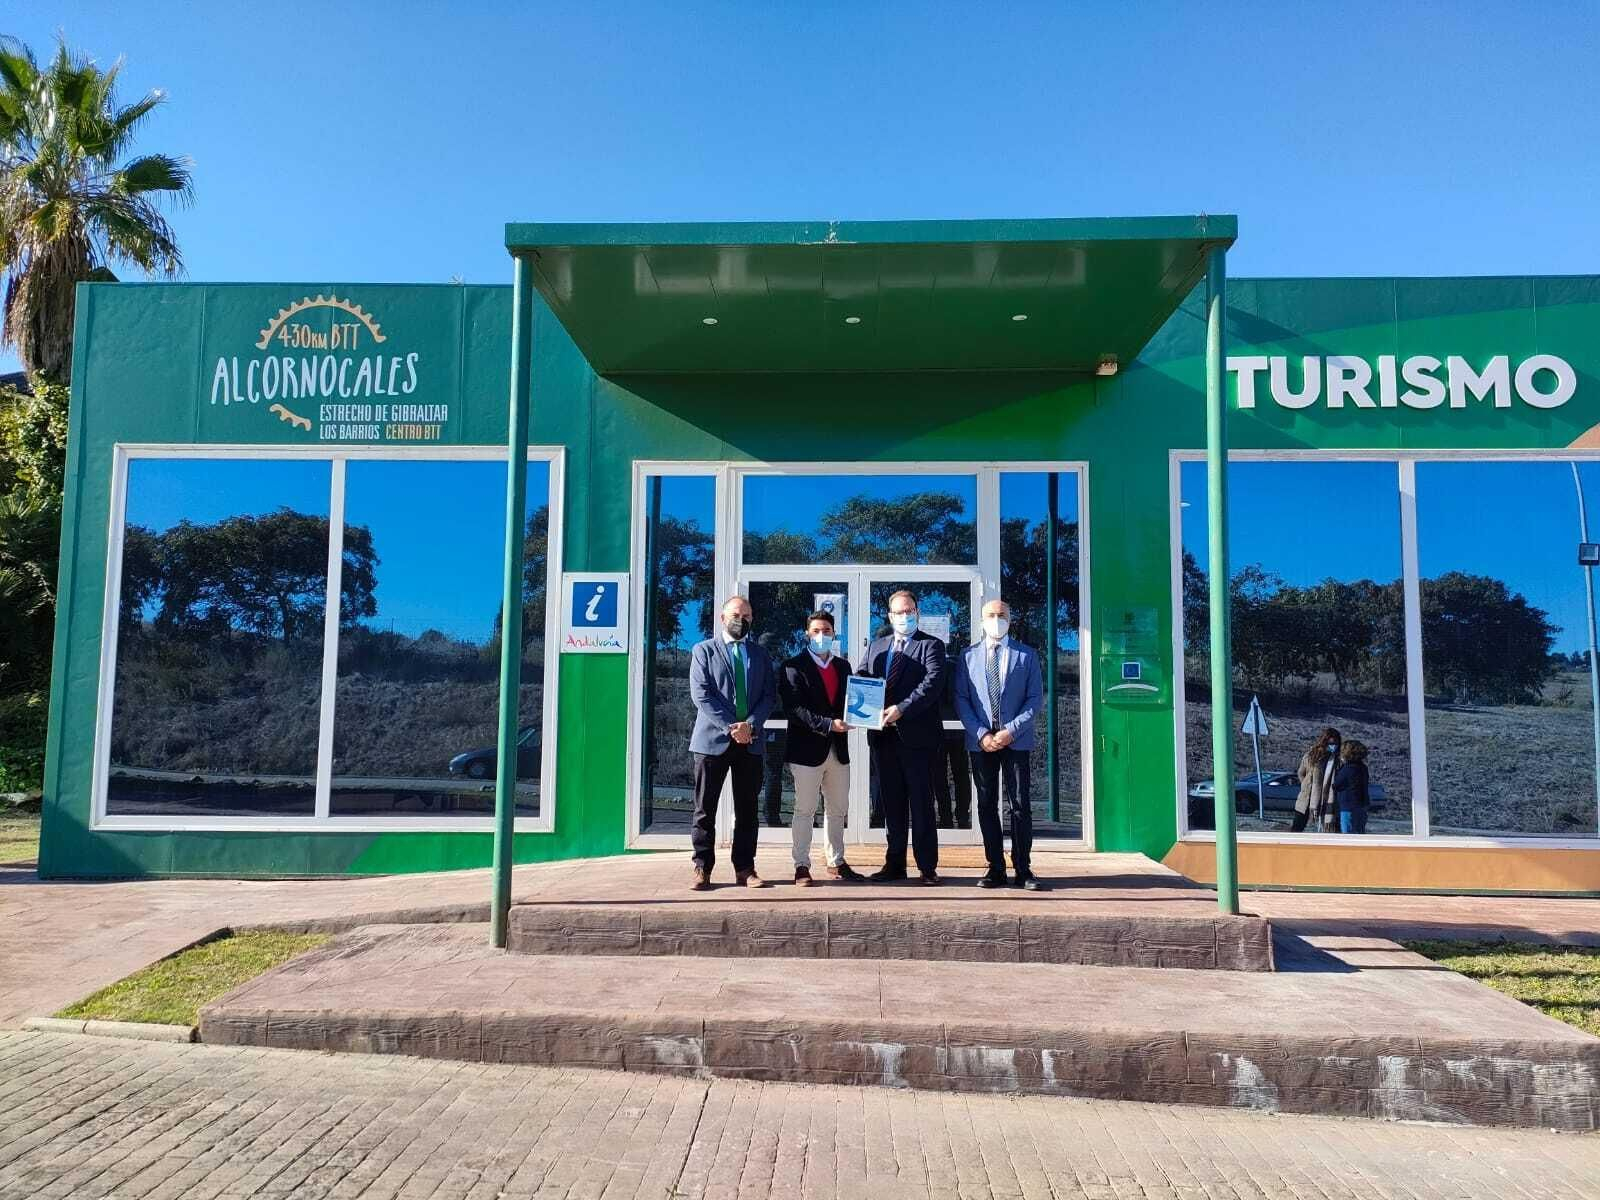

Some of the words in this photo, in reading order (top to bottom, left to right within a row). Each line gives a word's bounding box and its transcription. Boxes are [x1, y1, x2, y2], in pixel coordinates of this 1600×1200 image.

[332, 323, 361, 350] BTT
[211, 352, 419, 406] ALCORNOCALES
[1226, 354, 1577, 409] TURISMO
[320, 404, 372, 421] ESTRECHO
[375, 404, 388, 421] DE
[391, 404, 448, 422] GIBRALTAR
[320, 424, 337, 440] LOS
[340, 424, 380, 440] BARRIOS
[386, 424, 421, 440] CENTRO
[424, 424, 441, 440] BTT
